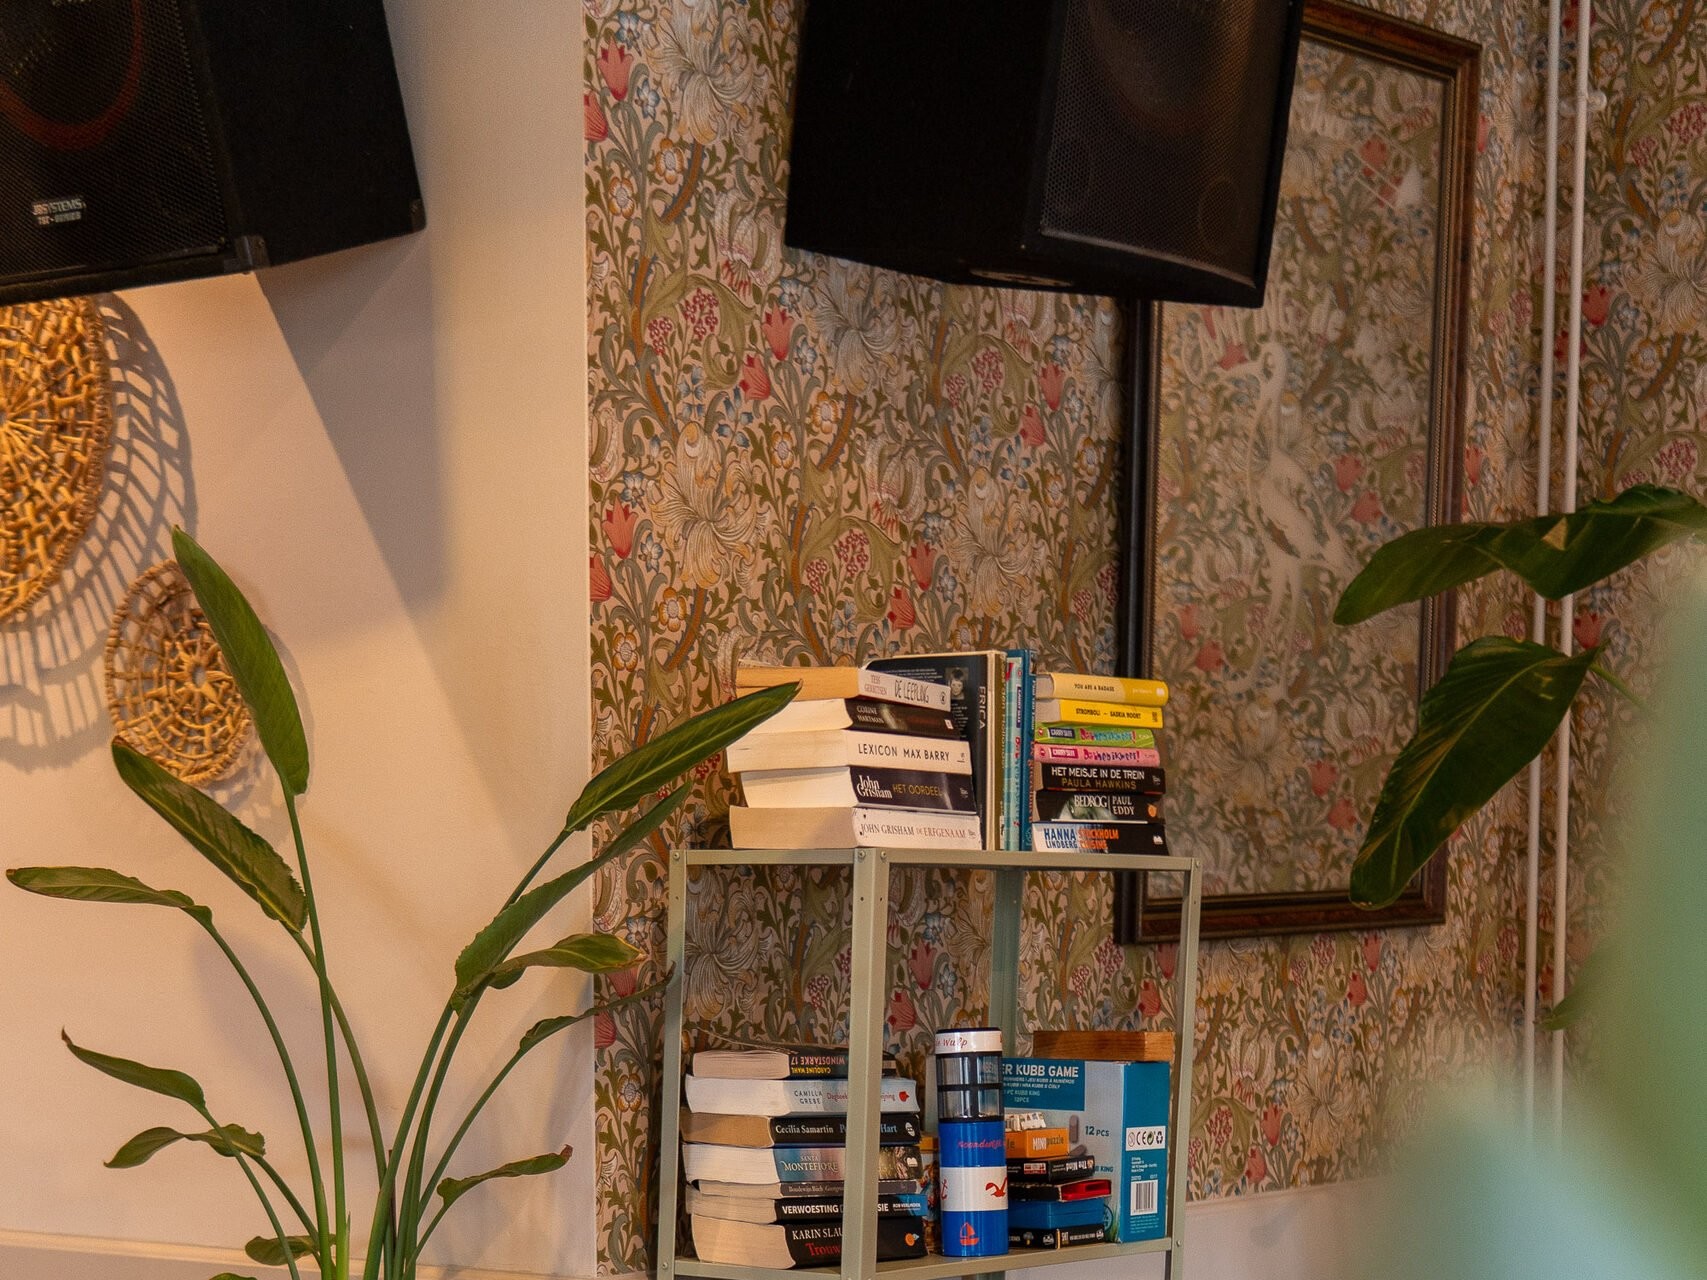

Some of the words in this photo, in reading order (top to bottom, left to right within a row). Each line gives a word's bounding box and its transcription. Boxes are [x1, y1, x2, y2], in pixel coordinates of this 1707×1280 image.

[1074, 683, 1083, 691] YOU
[1075, 708, 1100, 716] STROMBOLI
[858, 743, 898, 757] LEXICON
[903, 748, 921, 759] MAX
[924, 749, 950, 761] BARRY
[1051, 766, 1067, 776] HET
[1068, 768, 1098, 778] MEISJE
[1100, 769, 1108, 778] IN
[1110, 769, 1121, 779] DE
[1124, 770, 1145, 780] TREIN
[858, 774, 880, 790] John
[1062, 778, 1093, 788] PAULA
[1095, 780, 1137, 790] HAWKINS
[856, 782, 893, 799] Grisham
[892, 783, 906, 794] HET
[908, 784, 943, 796] OORDEEL
[1074, 794, 1108, 808] BEDROG
[1112, 796, 1132, 806] PAUL
[1113, 806, 1135, 815] EDDY
[860, 823, 880, 836] JOHN
[881, 824, 915, 836] GRISHAM
[924, 828, 966, 839] ERFGENAAM
[1044, 828, 1077, 840] HANNA
[1078, 828, 1119, 839] STOCKHOLM
[1046, 840, 1078, 849] LINDBERG
[791, 1056, 799, 1066] 17
[1016, 1064, 1046, 1077] KUBB
[1048, 1065, 1079, 1078] GAME
[775, 1124, 800, 1134] Cecilia
[801, 1124, 834, 1134] Samartin
[880, 1124, 898, 1133] Hart
[1085, 1126, 1095, 1136] 12
[1096, 1129, 1110, 1137] PCS
[1032, 1137, 1047, 1151] MINI
[780, 1160, 839, 1173] MONTEFIORE
[781, 1204, 839, 1214] VERWOESTING
[792, 1228, 822, 1240] KARIN
[805, 1243, 841, 1256] Trouw
